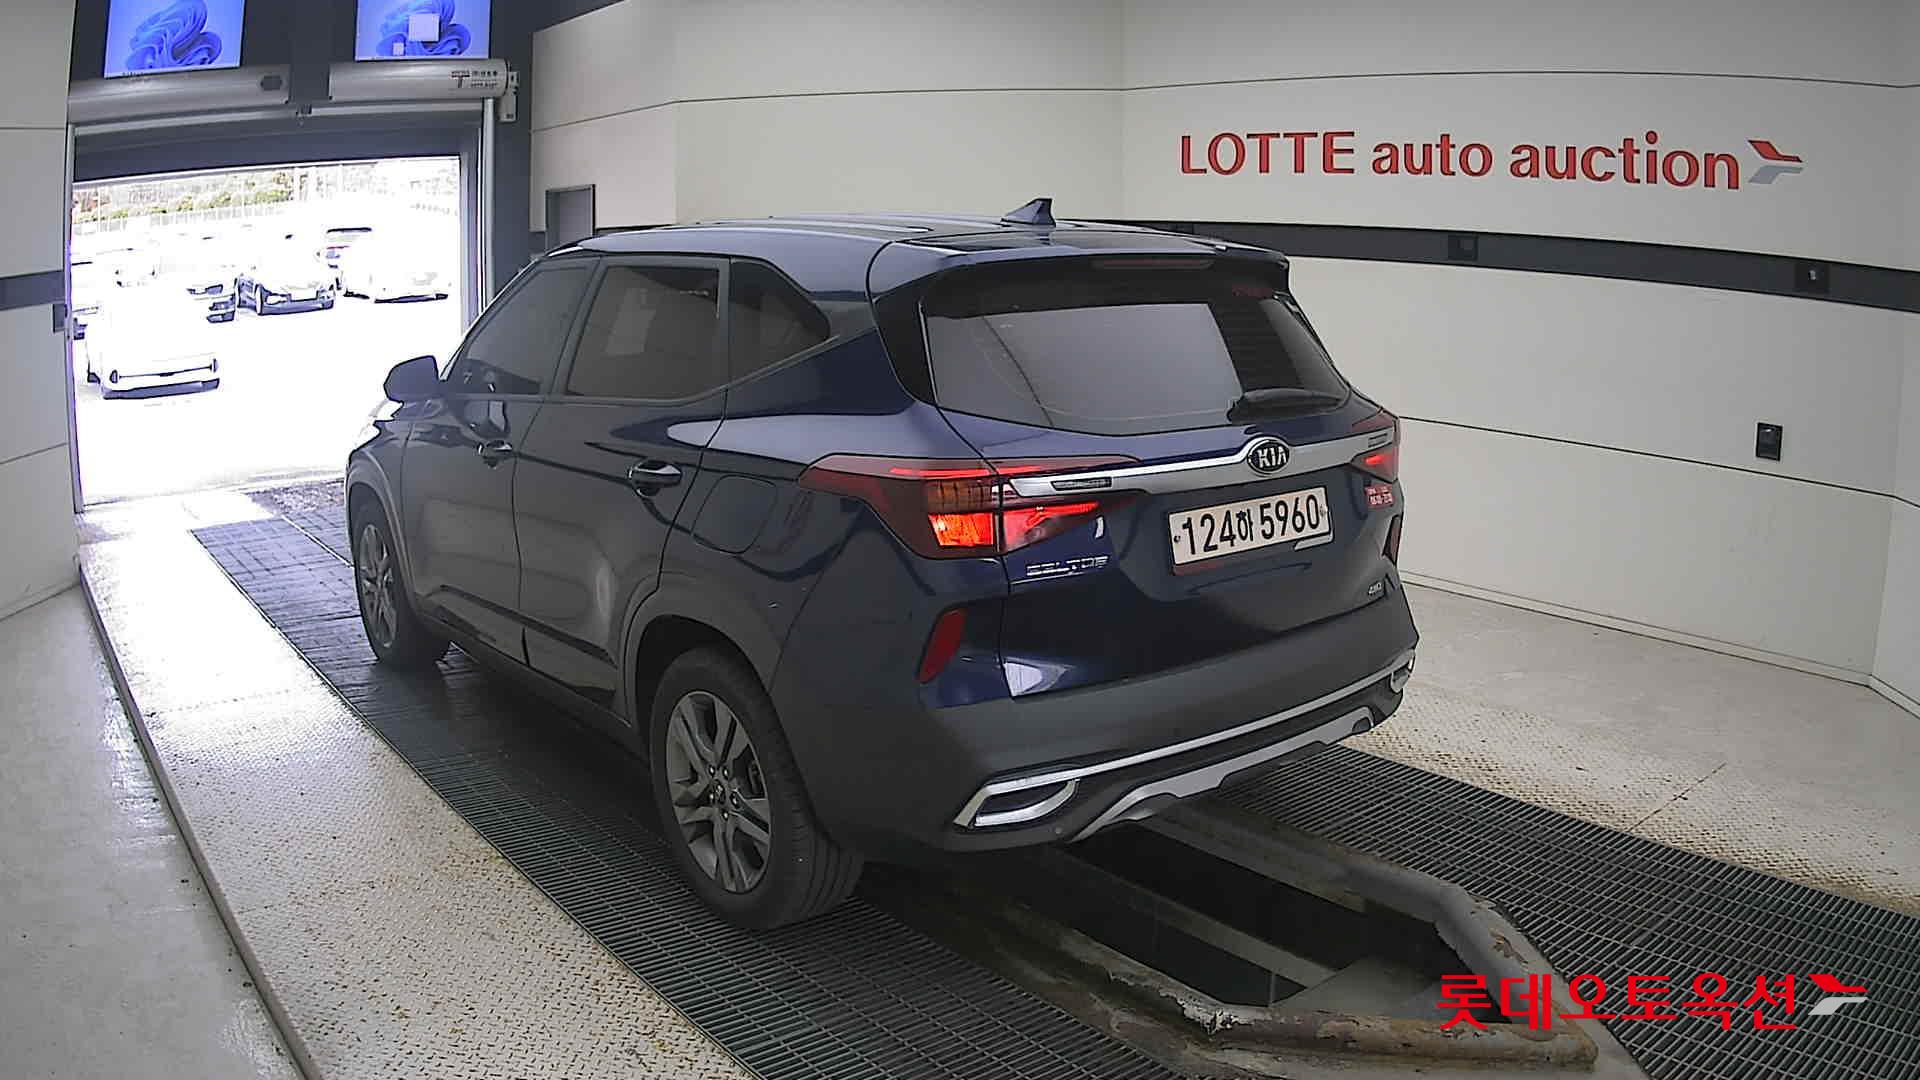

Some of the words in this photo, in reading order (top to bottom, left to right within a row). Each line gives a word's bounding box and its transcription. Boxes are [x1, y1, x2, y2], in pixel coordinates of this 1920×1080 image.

[1180, 131, 1356, 175] LOTTE
[1371, 133, 1493, 177] auto
[1510, 130, 1741, 190] auction
[1257, 445, 1287, 468] KIA
